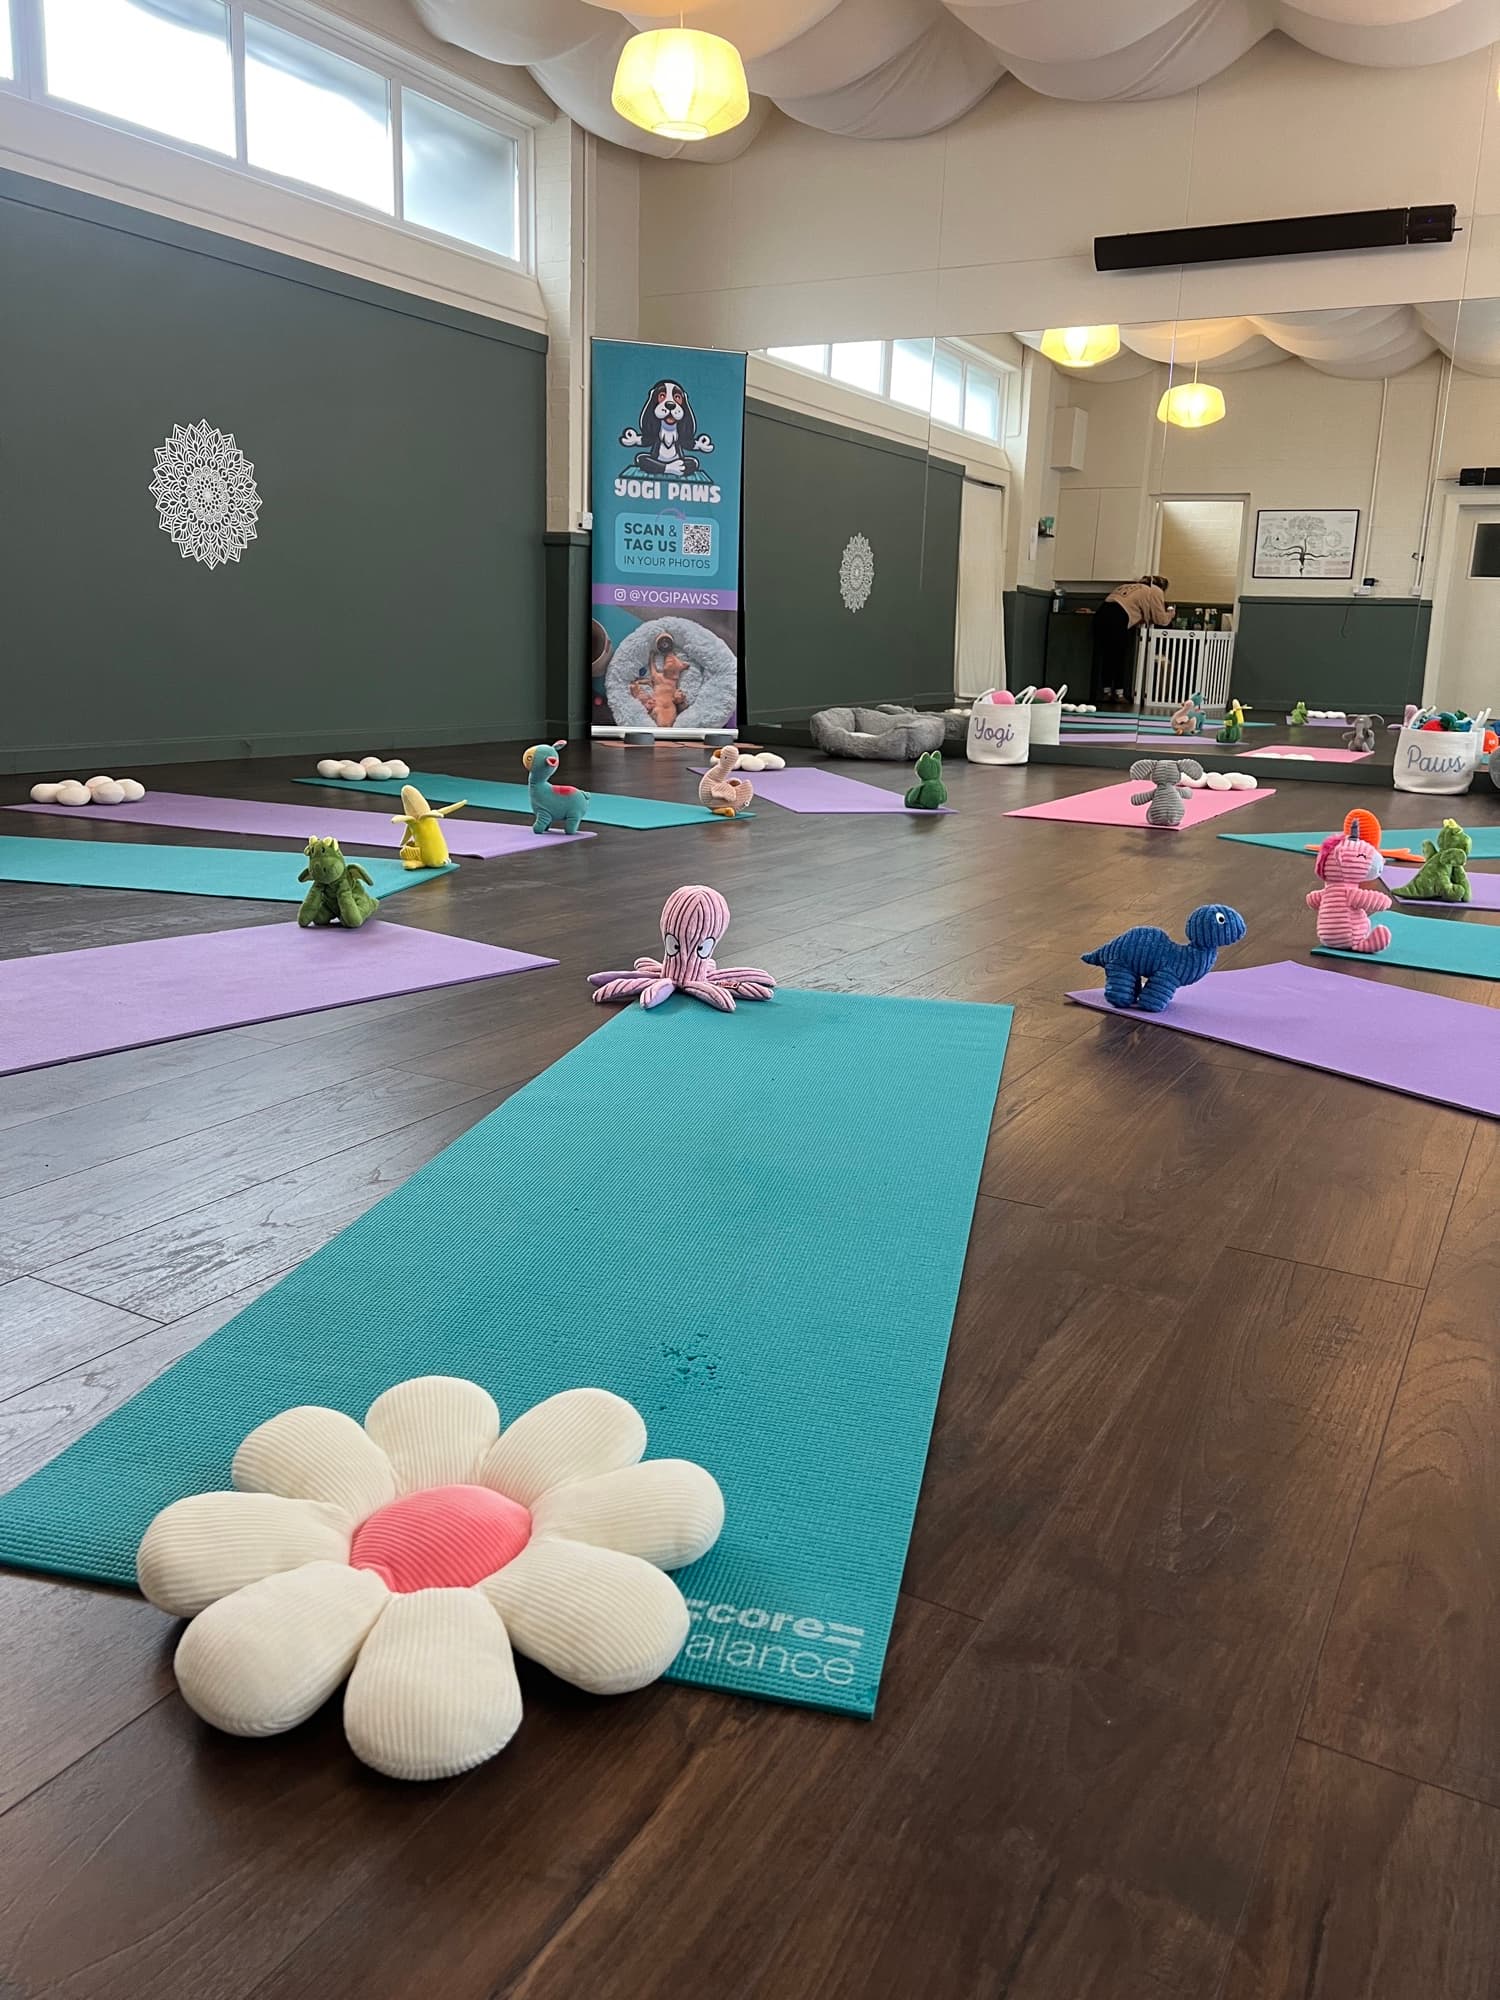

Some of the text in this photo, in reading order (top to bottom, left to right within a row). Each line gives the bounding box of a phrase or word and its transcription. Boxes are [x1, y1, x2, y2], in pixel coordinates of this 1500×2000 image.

[614, 478, 721, 503] YOGI PAWS
[623, 522, 677, 537] SCAN &
[623, 538, 677, 553] TAG US
[624, 555, 711, 569] IN YOUR PHOTOS
[629, 590, 719, 606] @YOGIPAWSS
[974, 717, 1015, 748] Yogi
[1407, 745, 1466, 773] Paws
[685, 1630, 855, 1685] alance
